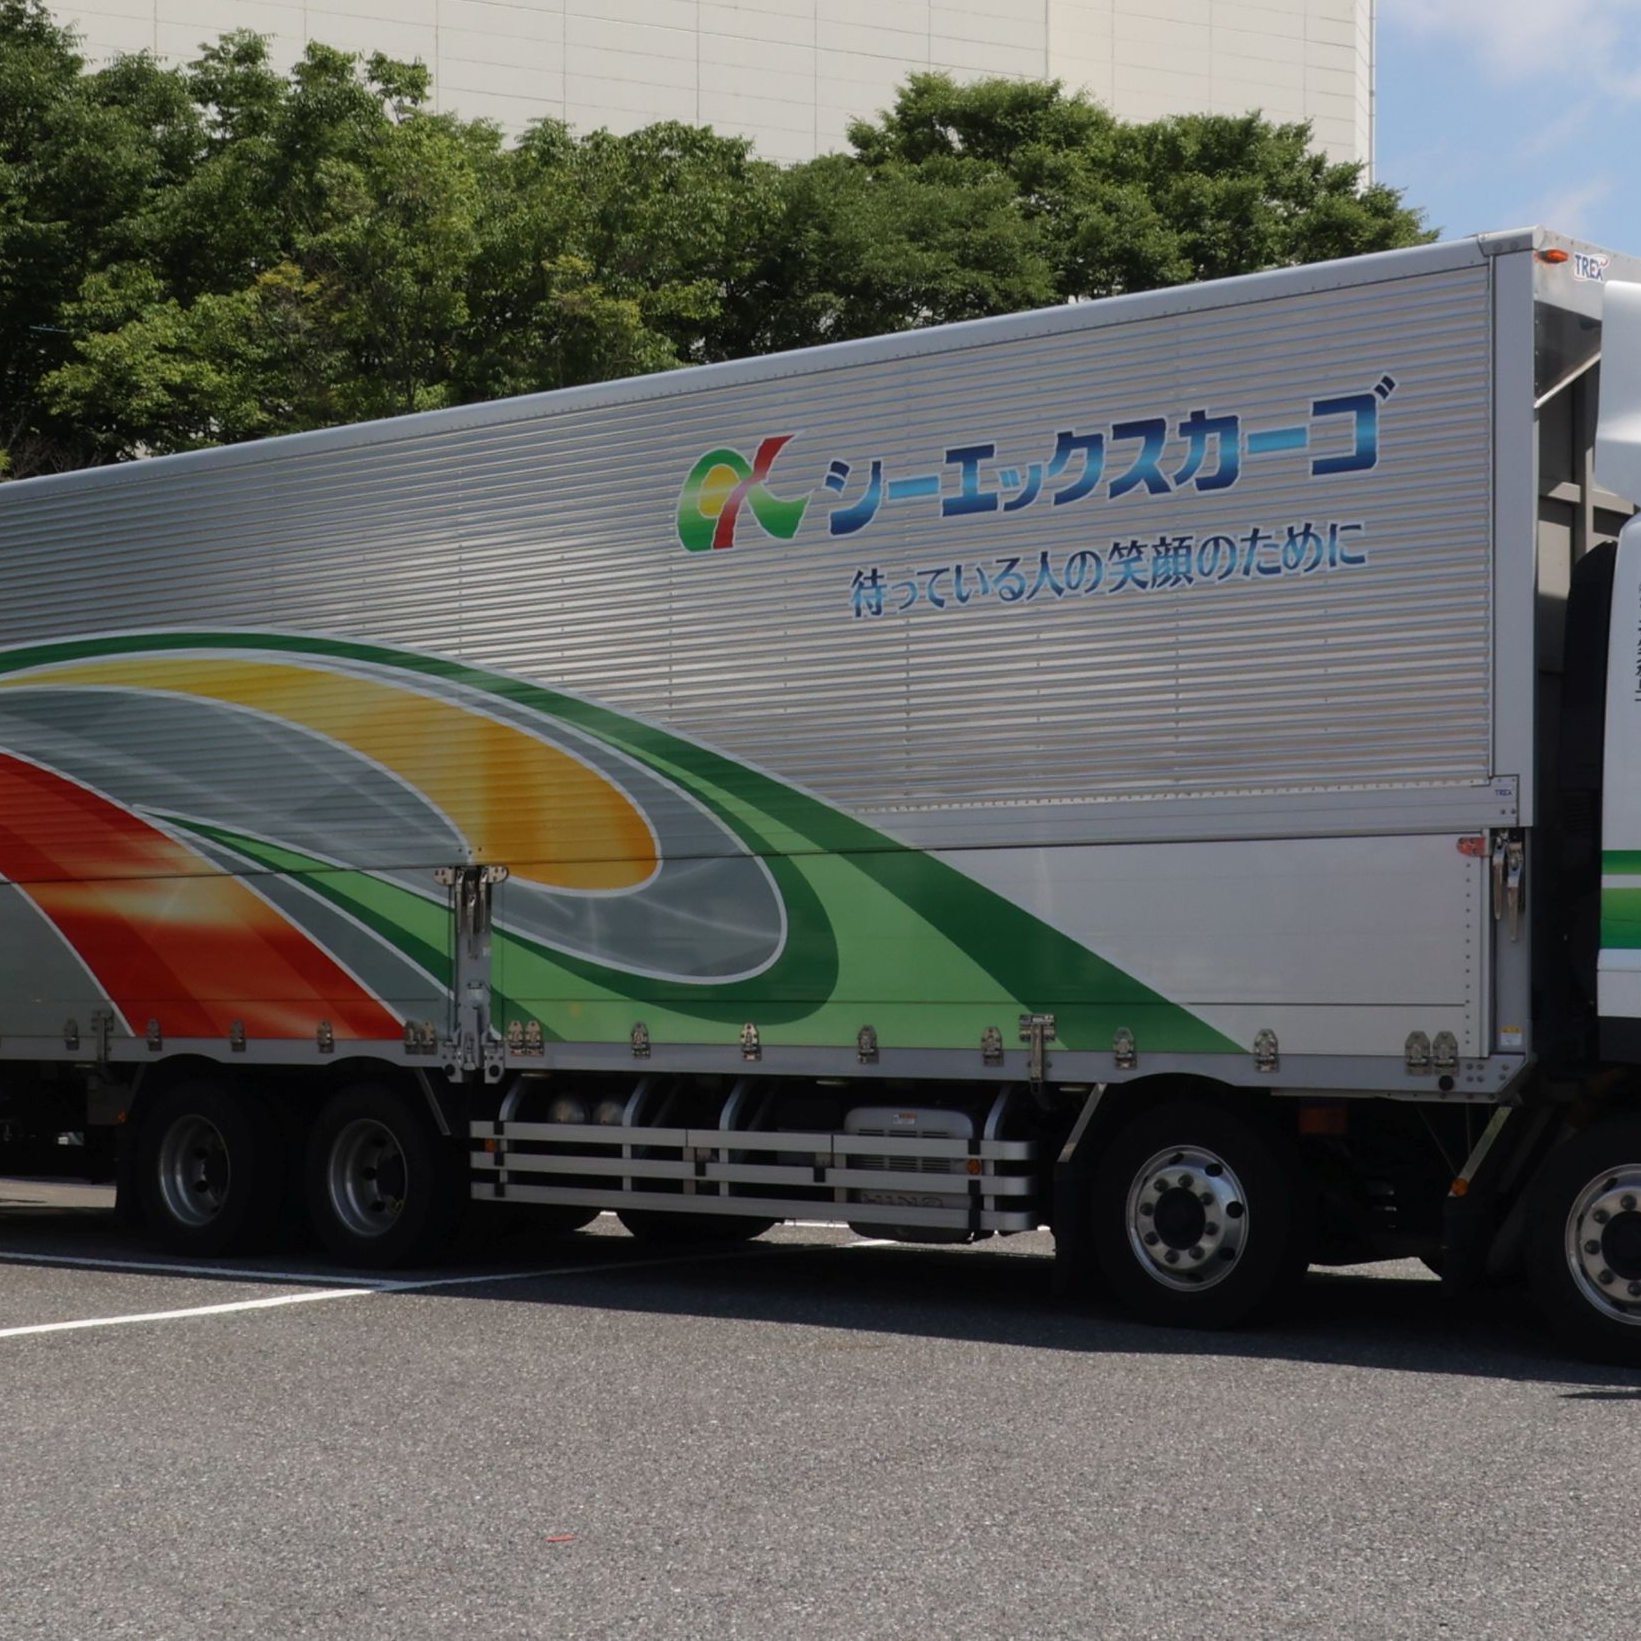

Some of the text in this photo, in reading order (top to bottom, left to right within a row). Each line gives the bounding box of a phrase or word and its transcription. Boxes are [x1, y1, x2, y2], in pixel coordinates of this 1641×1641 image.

[822, 373, 1398, 537] シーエックスカーゴ
[850, 521, 1367, 619] 待っている人の笑顔のために
